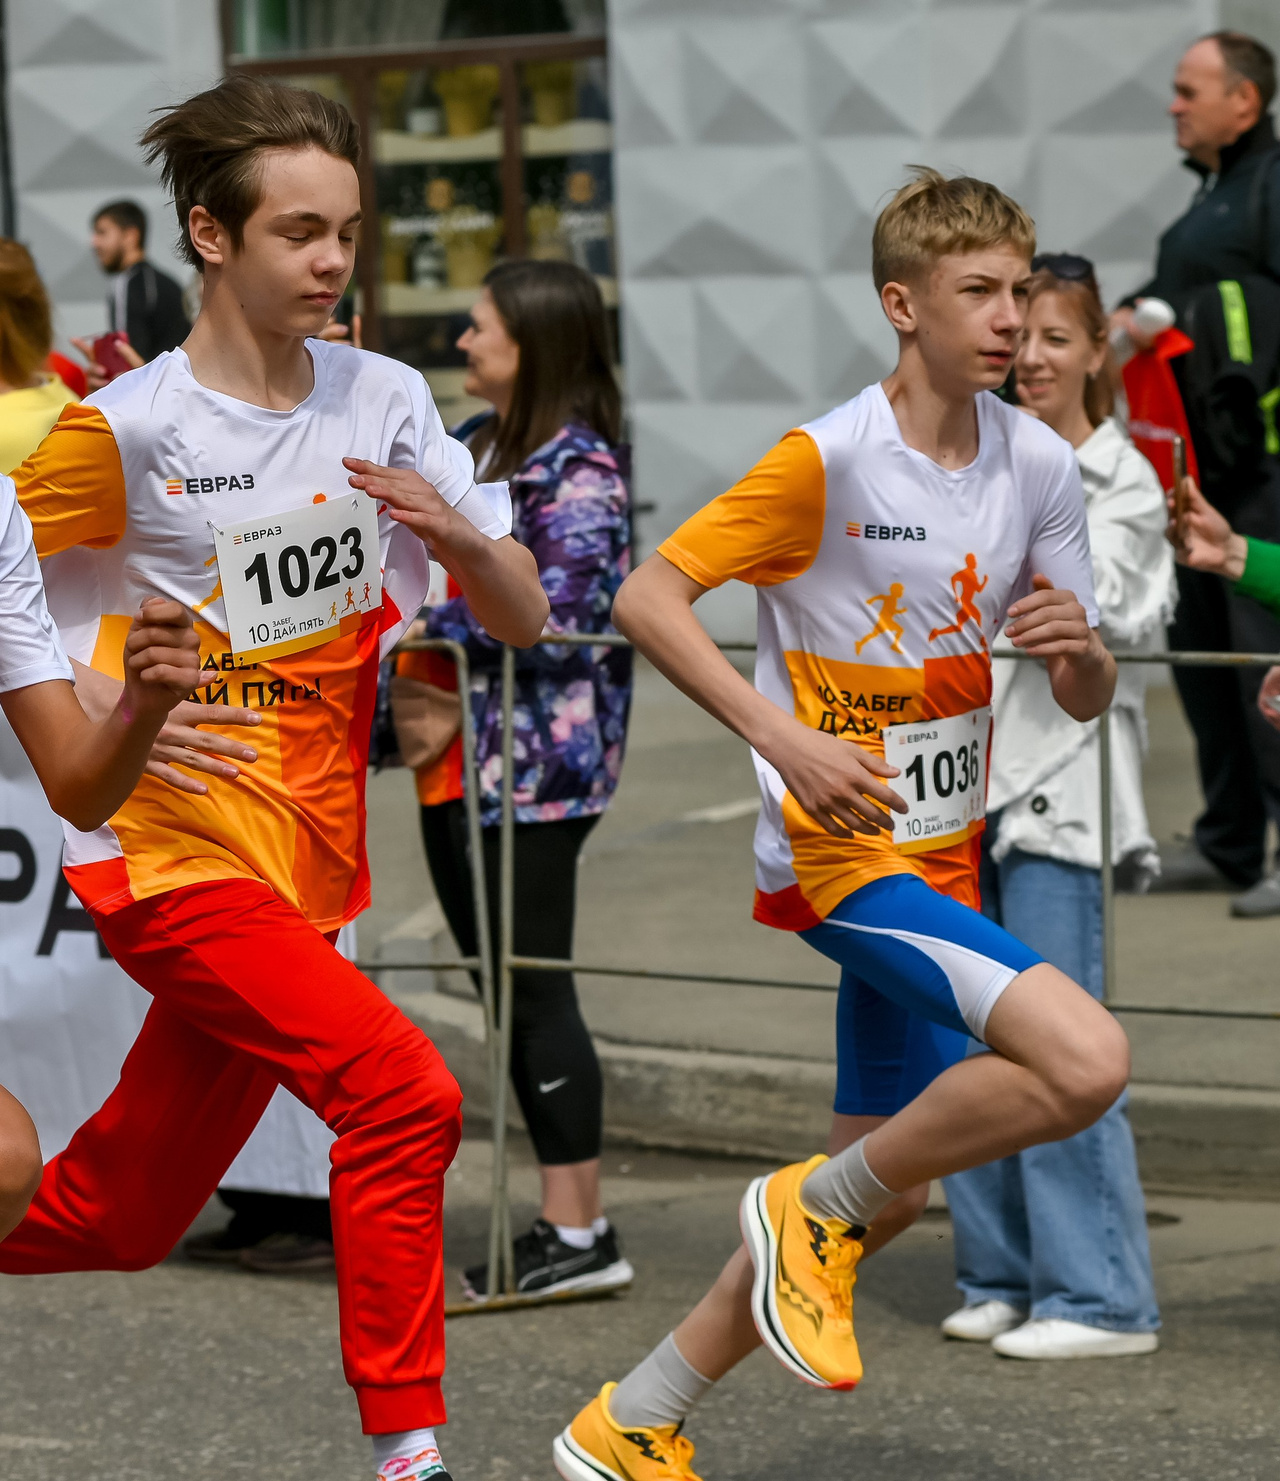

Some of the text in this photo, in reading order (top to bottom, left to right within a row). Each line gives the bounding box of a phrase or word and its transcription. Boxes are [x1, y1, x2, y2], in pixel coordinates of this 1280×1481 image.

[185, 474, 255, 494] ЕВРАЗ
[243, 526, 282, 543] ЕВРАЗ
[864, 524, 926, 541] ЕВРАЗ
[244, 526, 365, 606] 1023
[272, 616, 292, 628] ЗАБЕГ
[273, 616, 324, 641] ДАЙ ПЯТЬ
[248, 623, 270, 644] 10
[840, 690, 912, 712] ЗАБЕГ
[907, 730, 939, 744] ЕВРАЗ
[905, 739, 979, 802] 1036
[906, 818, 922, 837] 10
